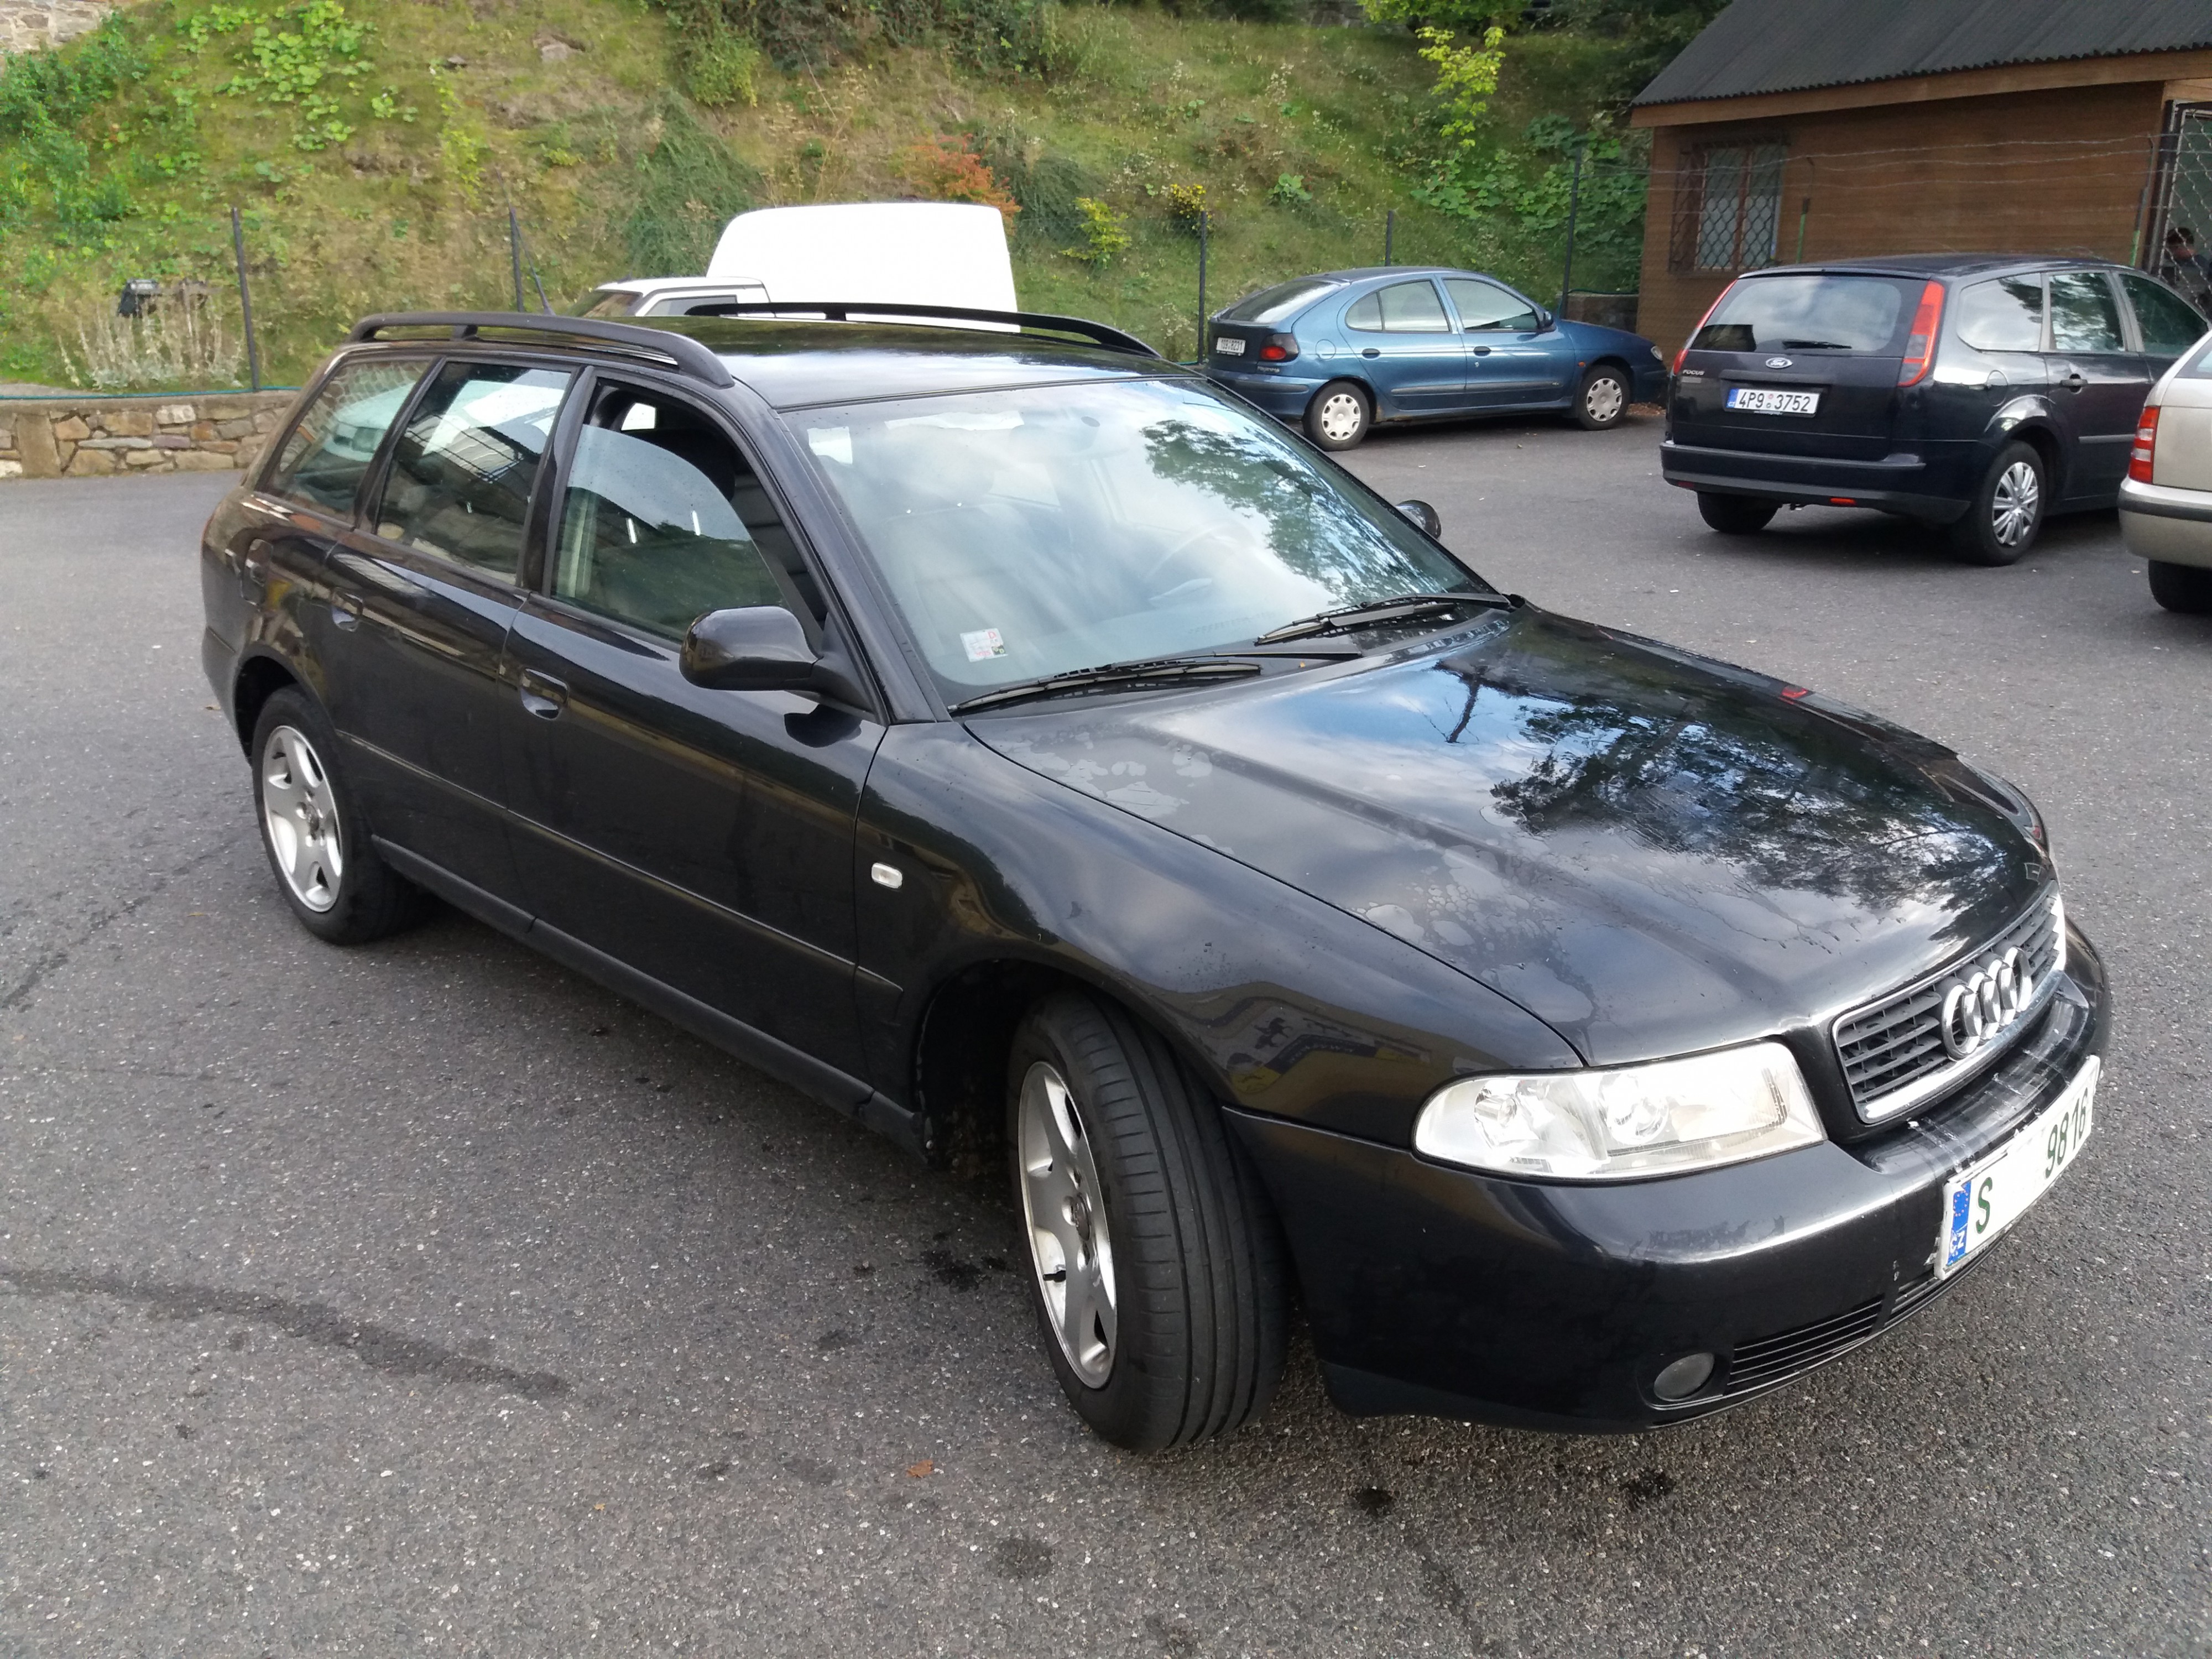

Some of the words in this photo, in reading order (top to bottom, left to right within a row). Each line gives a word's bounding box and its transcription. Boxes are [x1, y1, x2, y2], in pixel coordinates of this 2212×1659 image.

[1739, 392, 1765, 408] 4P9
[1774, 394, 1811, 411] 3752
[1976, 1177, 1992, 1234] S
[2046, 1087, 2088, 1178] 9816
